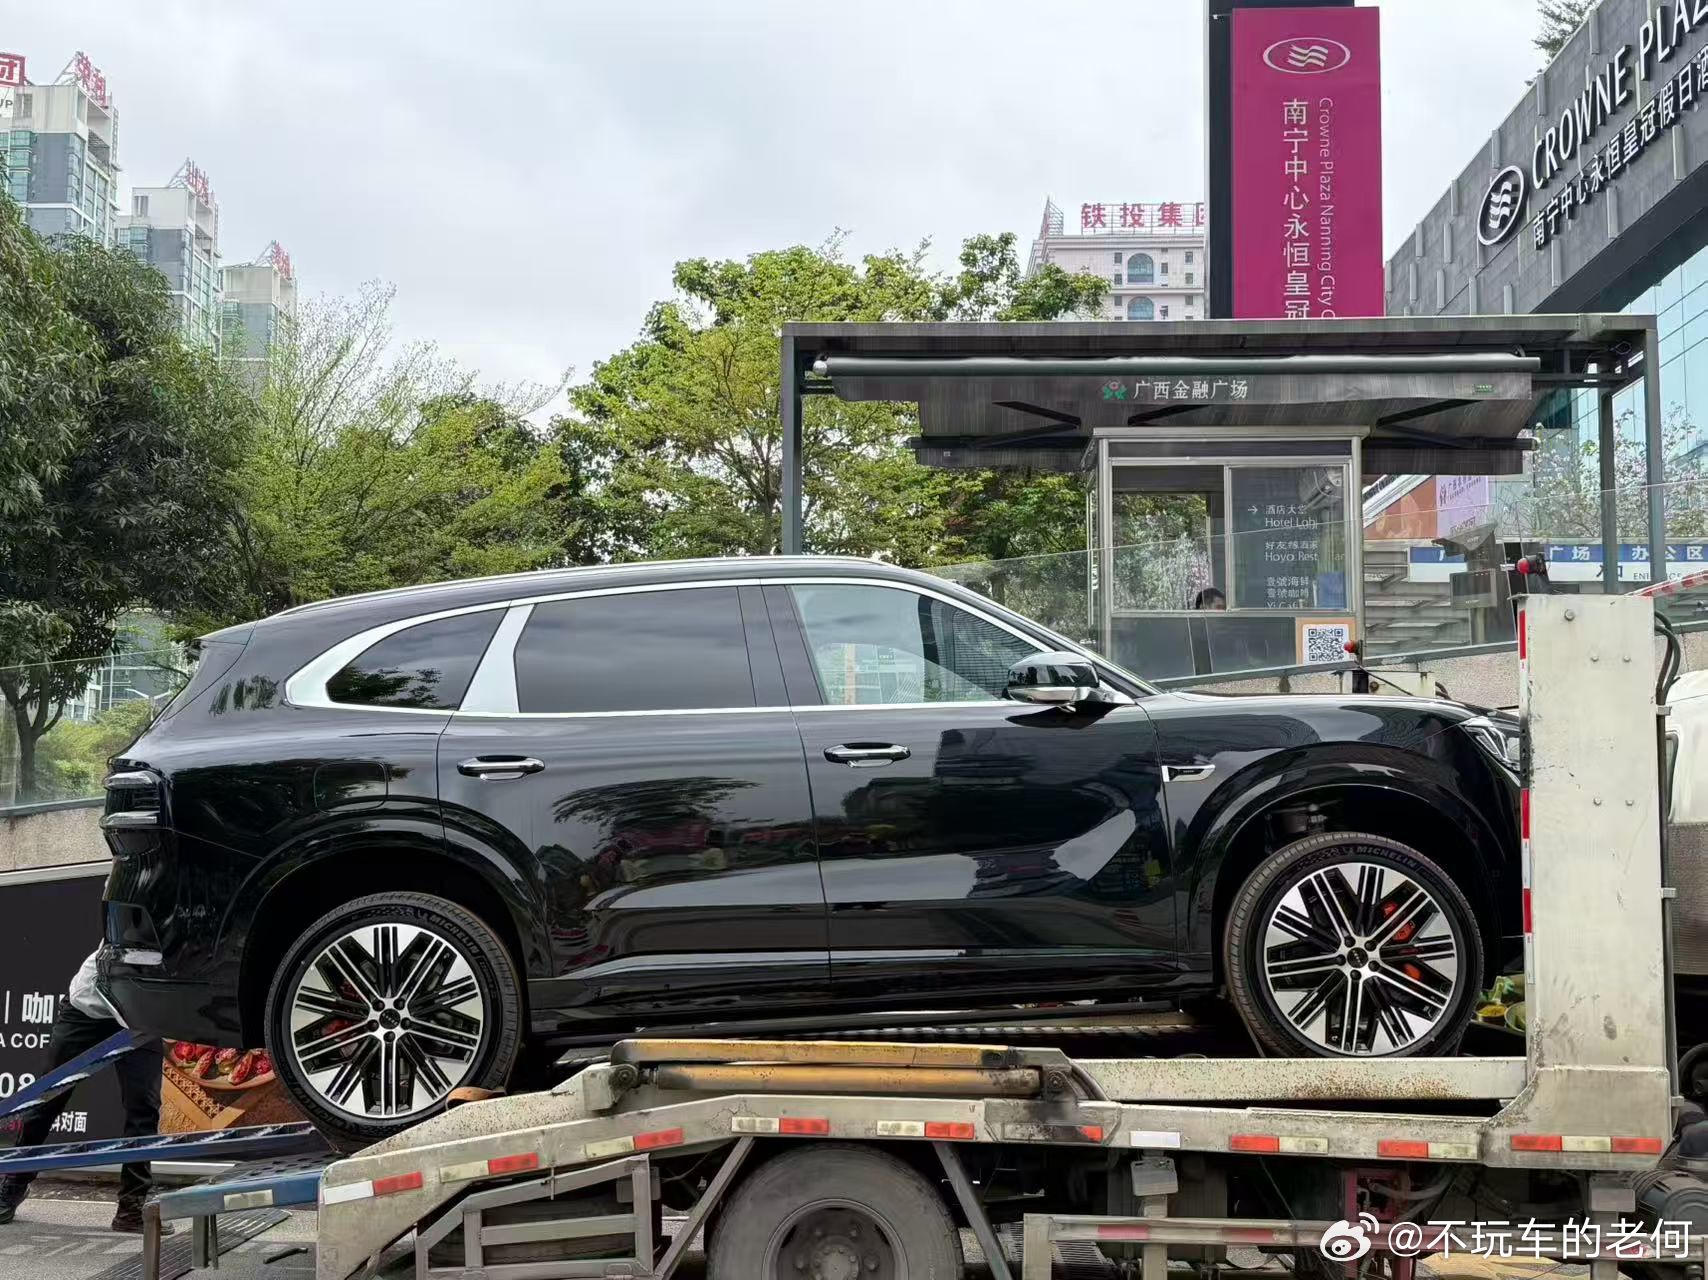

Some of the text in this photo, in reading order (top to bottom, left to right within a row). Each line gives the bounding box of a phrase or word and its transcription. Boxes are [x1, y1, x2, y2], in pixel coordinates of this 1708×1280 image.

[1319, 97, 1333, 158] Crowne
[1532, 45, 1630, 190] CROWNE
[1319, 161, 1334, 200] Plaza
[1282, 98, 1311, 318] 南宁中心永恒皇冠
[1317, 204, 1334, 271] Nanning
[1317, 275, 1335, 306] City
[1133, 379, 1248, 400] 广西金融广场
[1265, 517, 1294, 528] Hotel
[1265, 552, 1295, 563] Hoyo
[1549, 546, 1591, 561] 广场
[1357, 846, 1418, 869] MICHELIN
[428, 913, 481, 955] MICHELIN
[22, 991, 65, 1025] 咖
